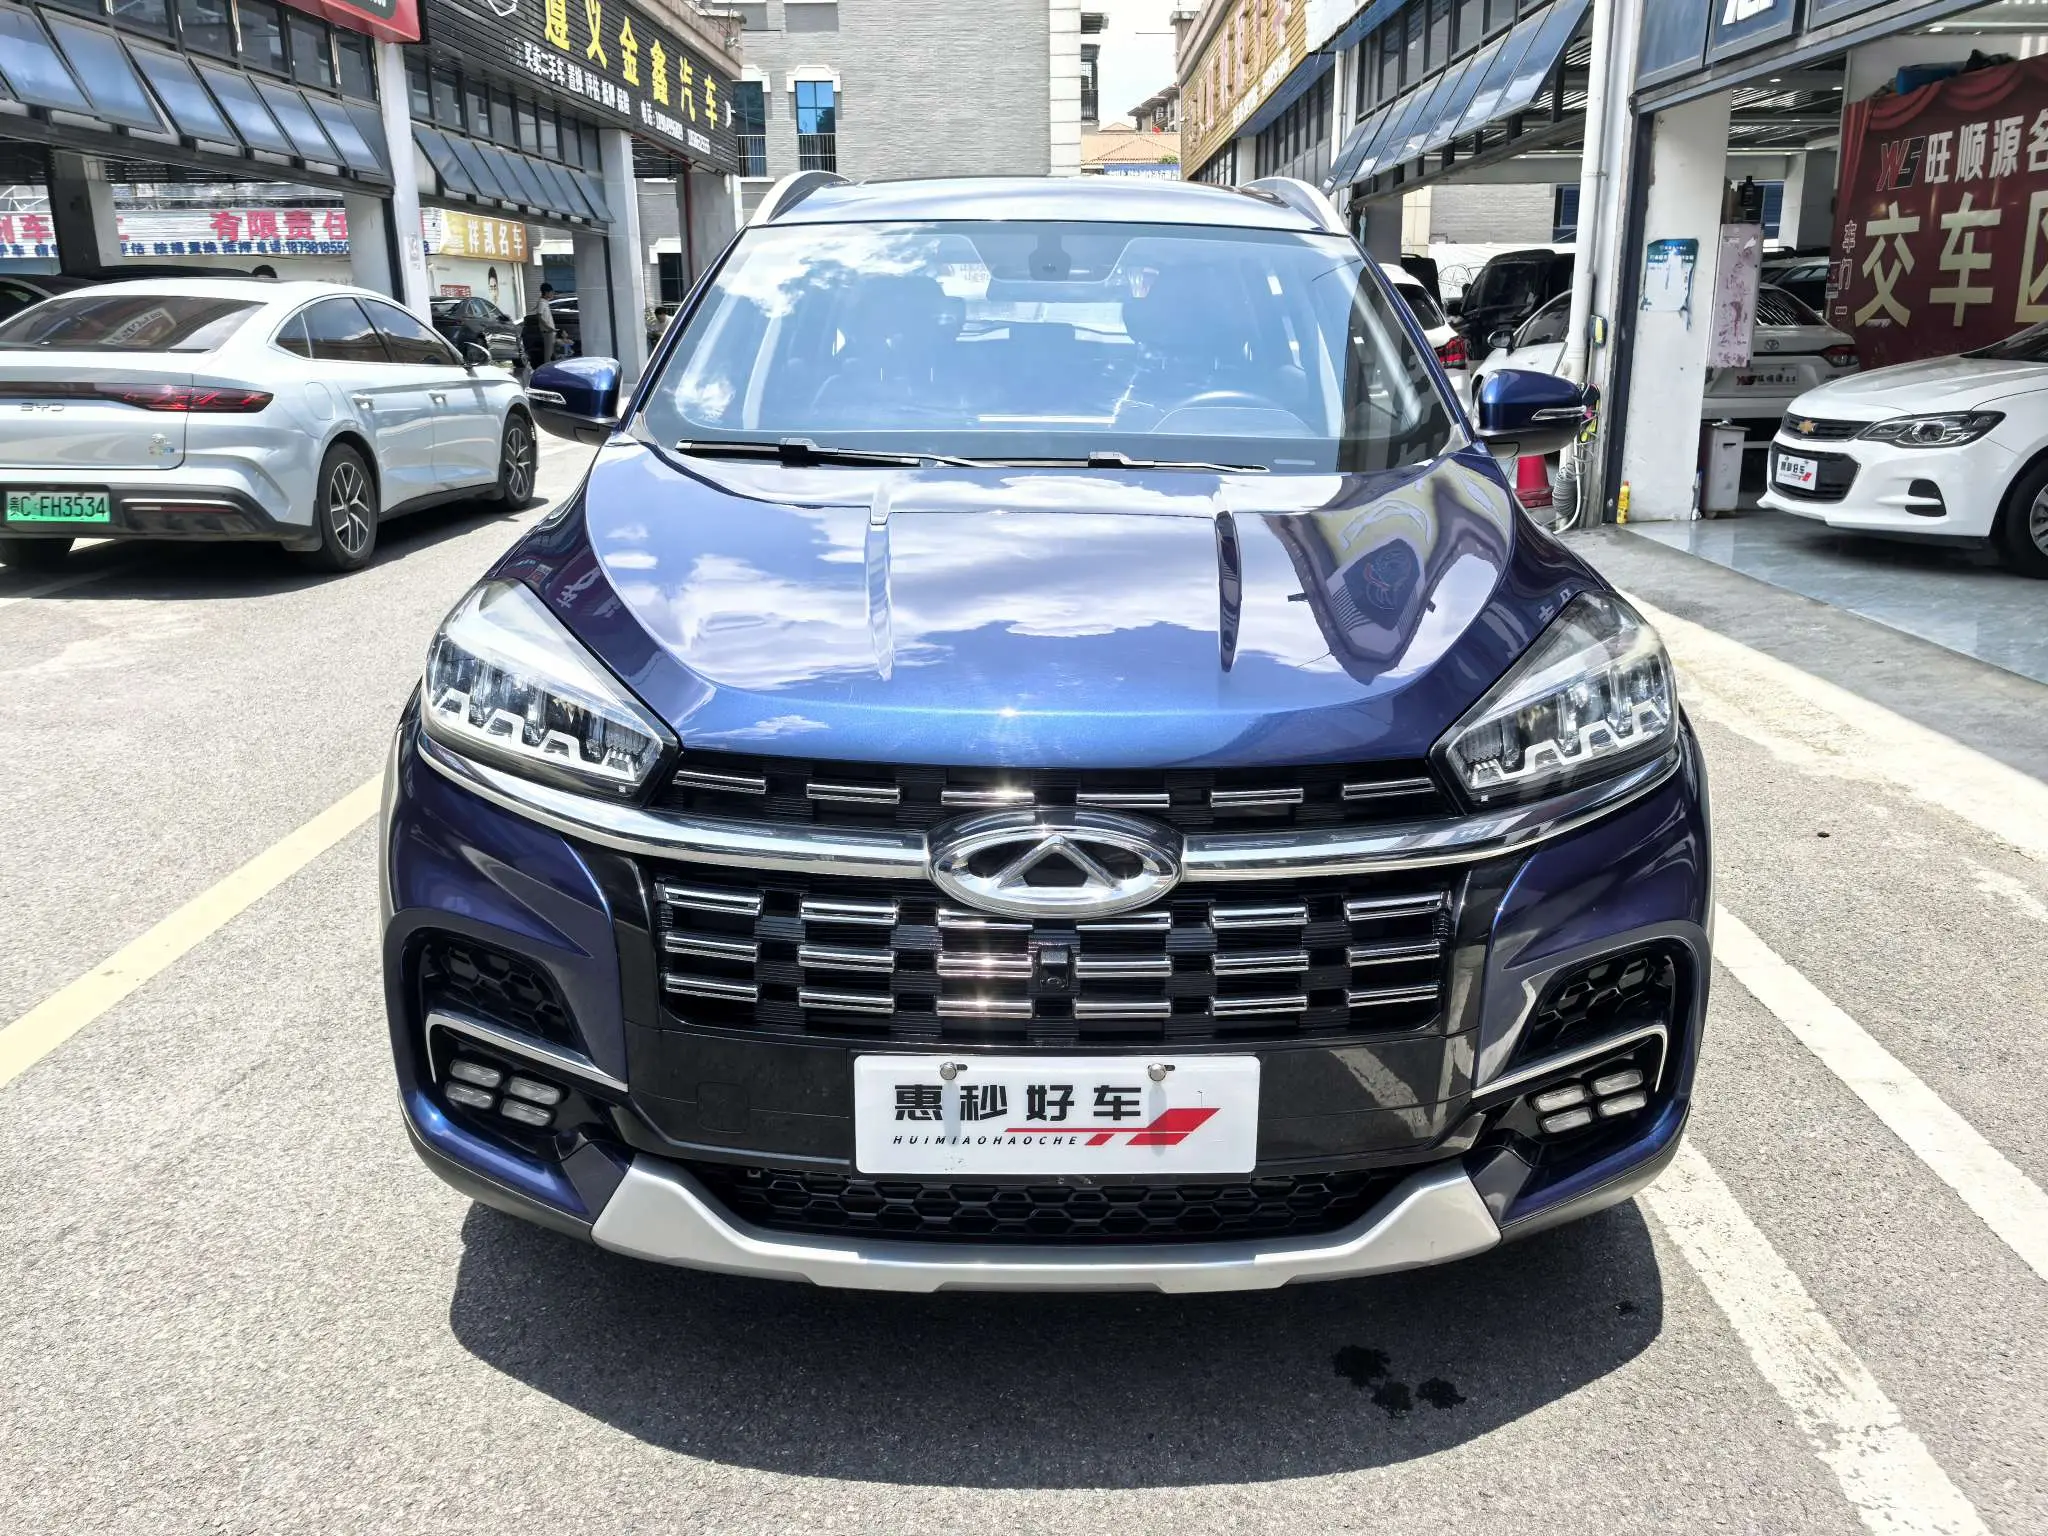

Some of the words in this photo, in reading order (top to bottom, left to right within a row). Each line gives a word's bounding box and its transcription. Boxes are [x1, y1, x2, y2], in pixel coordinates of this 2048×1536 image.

[894, 1084, 1142, 1121] 惠秒好车
[892, 1135, 1078, 1145] HUIMIAOHAOCHE
